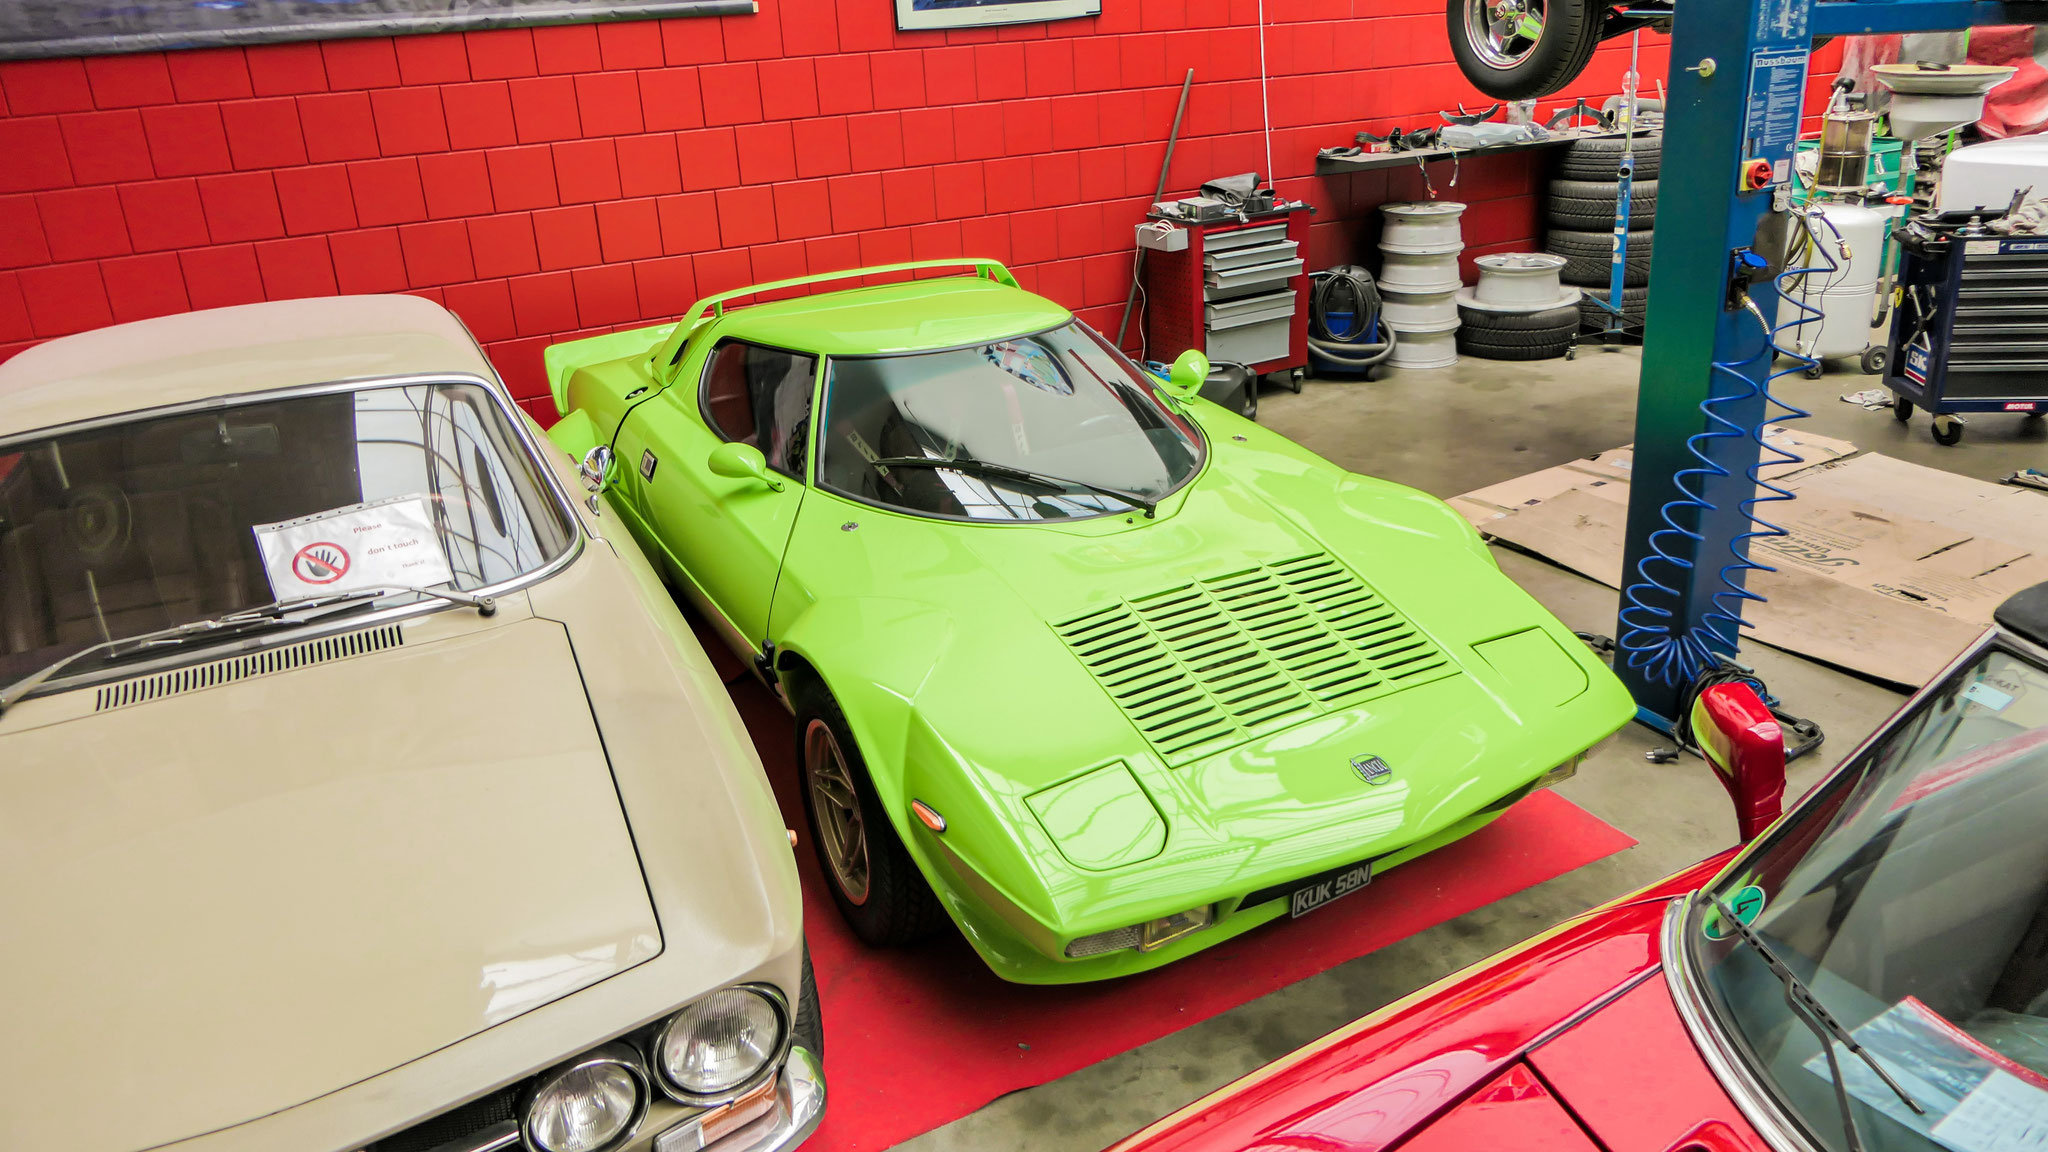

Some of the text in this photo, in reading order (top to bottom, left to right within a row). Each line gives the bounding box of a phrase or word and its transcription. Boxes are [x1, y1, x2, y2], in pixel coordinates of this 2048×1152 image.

[353, 523, 382, 534] Please
[393, 538, 419, 550] touch
[1296, 863, 1370, 913] KUK 58N
